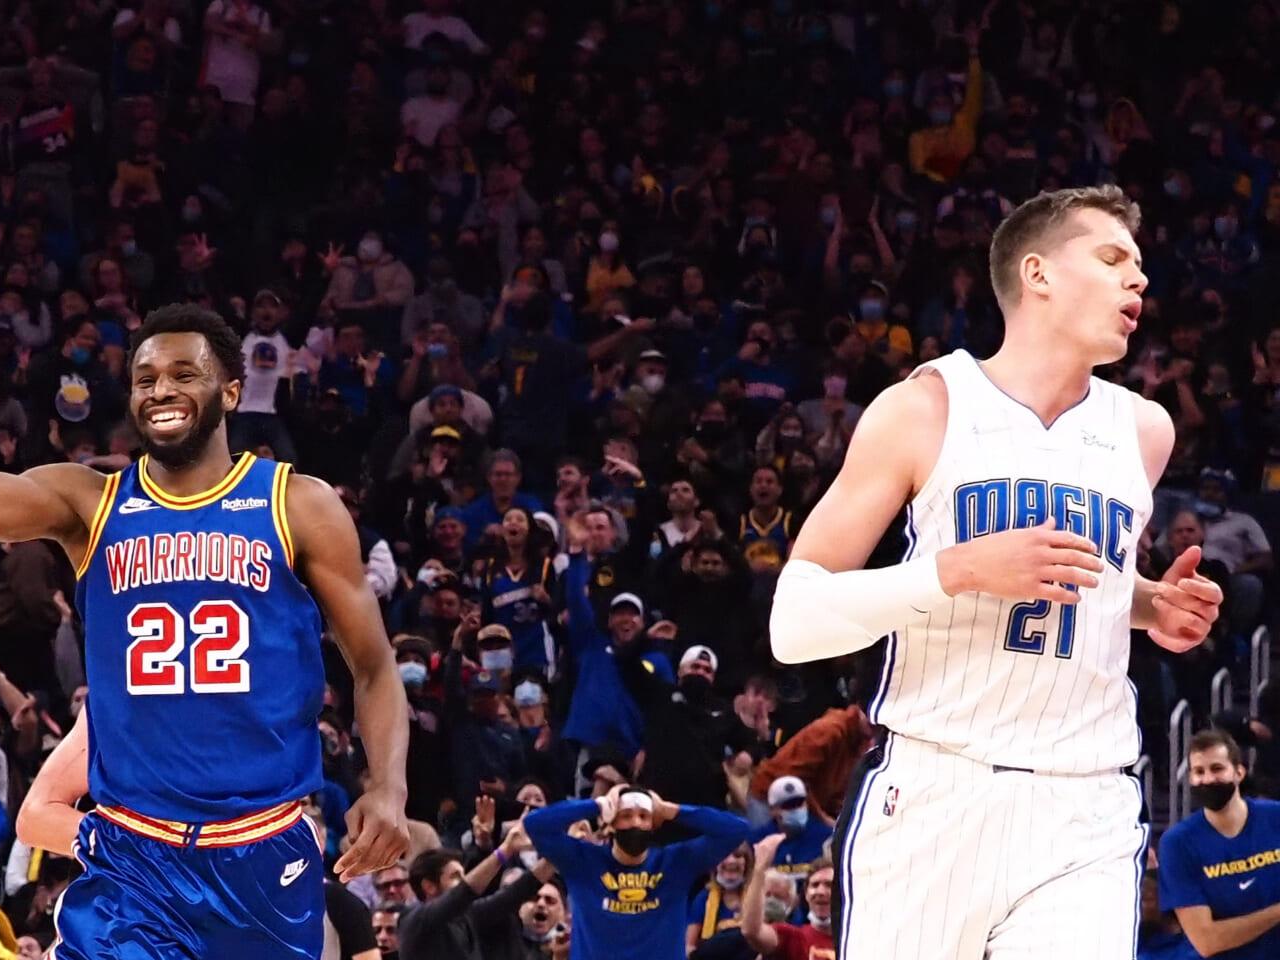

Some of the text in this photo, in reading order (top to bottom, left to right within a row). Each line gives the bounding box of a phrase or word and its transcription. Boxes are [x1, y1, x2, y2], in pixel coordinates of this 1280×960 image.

[221, 497, 268, 512] Rakuten
[953, 477, 1135, 573] MAGIC
[106, 531, 272, 595] WARRIORS
[126, 600, 250, 696] 22
[1003, 579, 1079, 660] 21
[1203, 848, 1280, 879] WARRIORS
